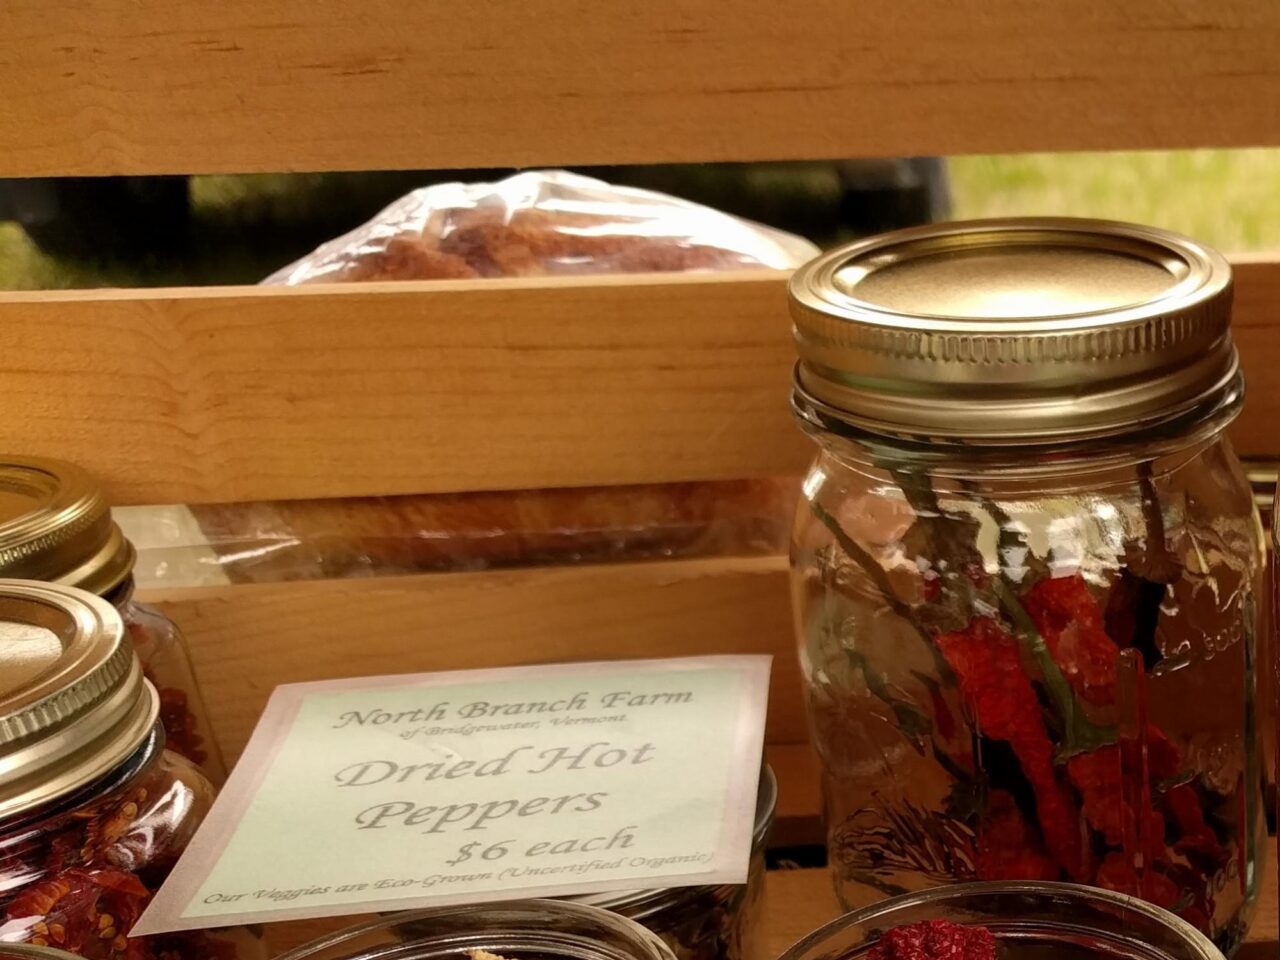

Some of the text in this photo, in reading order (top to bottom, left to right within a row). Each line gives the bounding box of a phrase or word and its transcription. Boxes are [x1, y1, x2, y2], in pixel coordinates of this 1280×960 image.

[332, 690, 694, 729] North Branch Farm
[399, 714, 627, 739] of Bridgewater, Vermont
[333, 742, 656, 788] Dried Hot
[355, 792, 608, 834] Peppers
[445, 825, 639, 865] $6 each
[203, 851, 714, 904] Our Veggies are Eco-Grown (Uncertified Organic)
